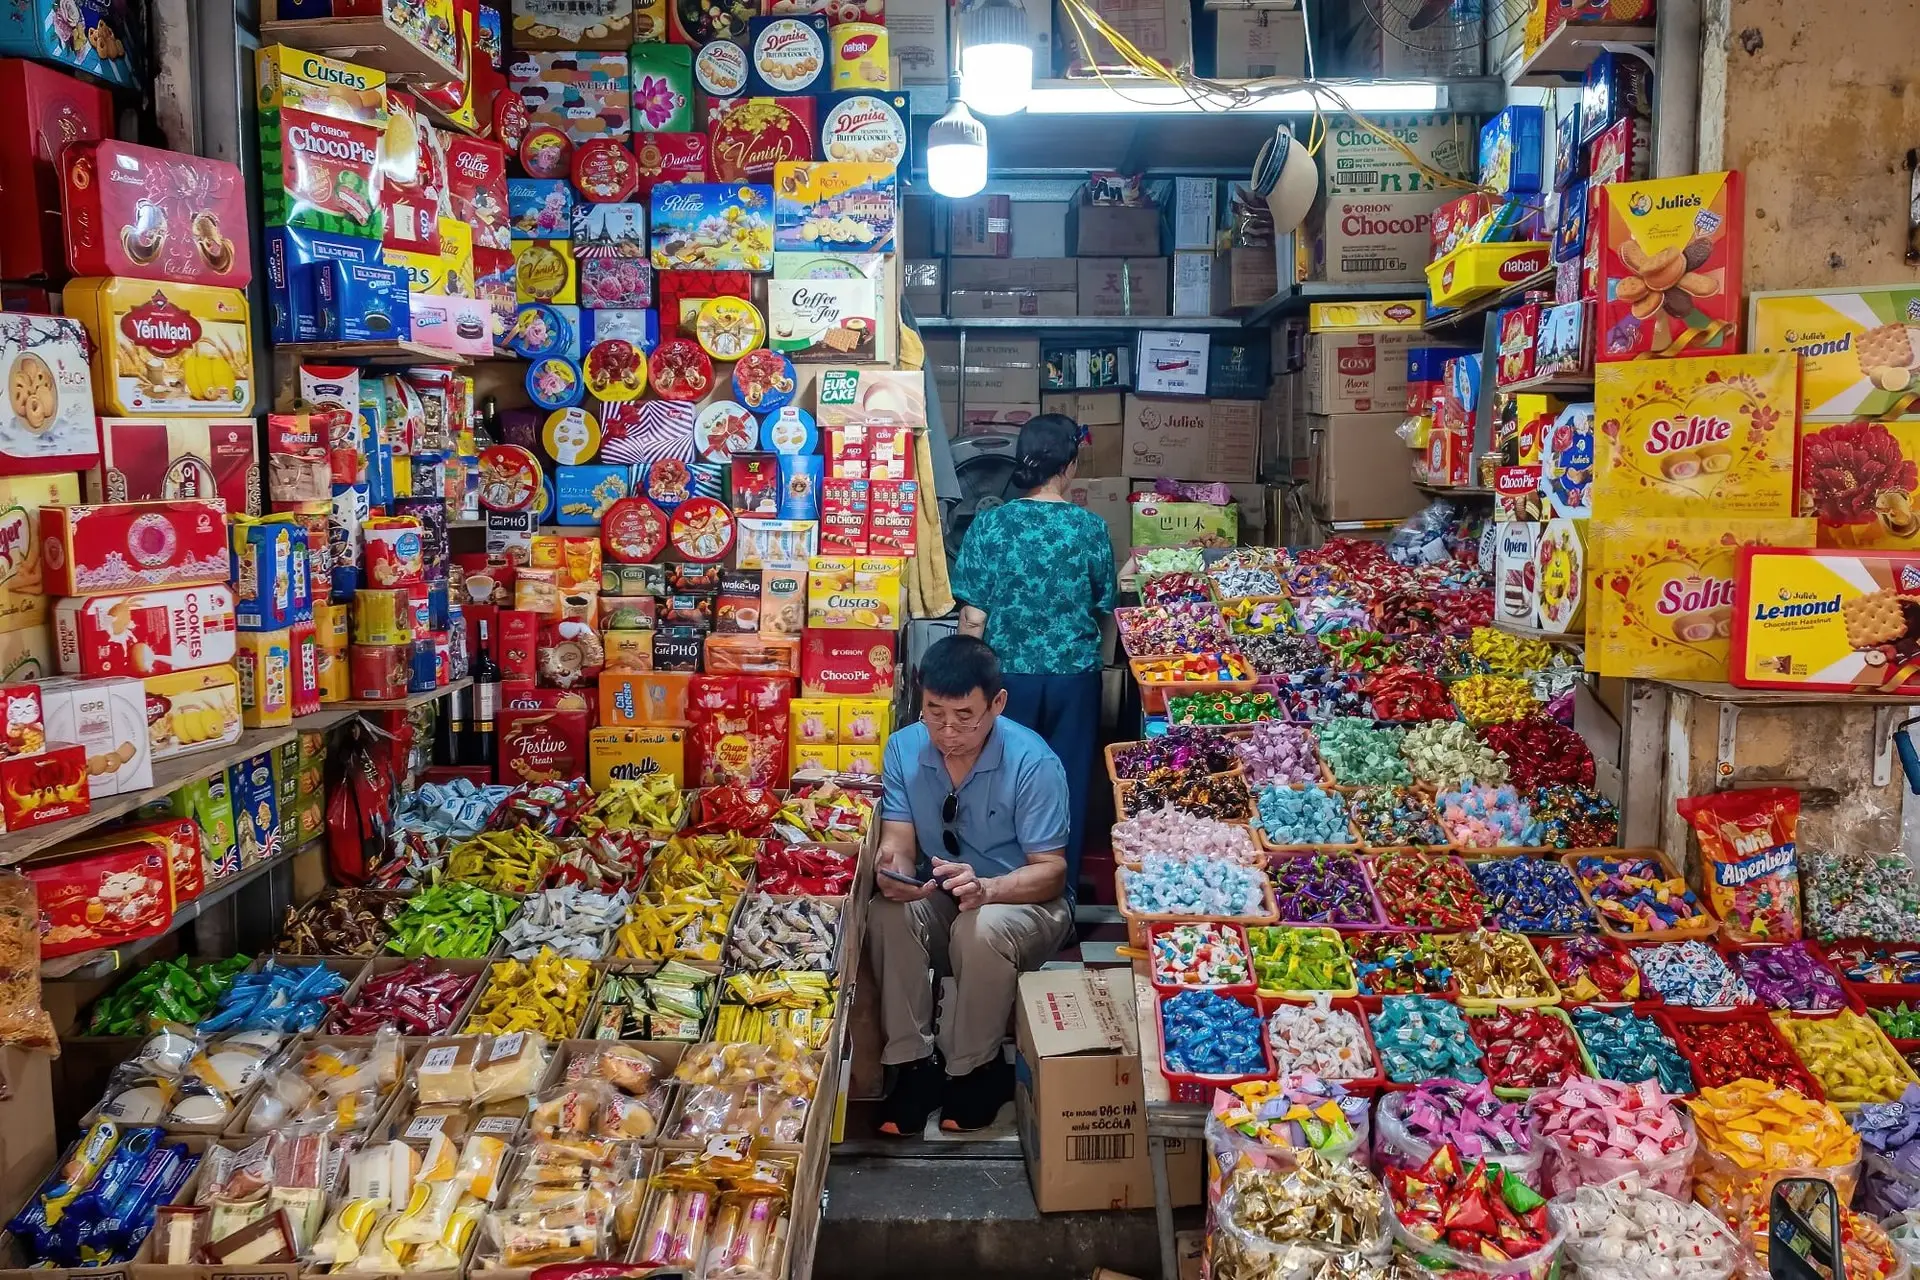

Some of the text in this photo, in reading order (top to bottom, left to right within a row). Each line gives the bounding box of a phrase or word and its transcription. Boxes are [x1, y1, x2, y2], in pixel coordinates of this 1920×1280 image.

[764, 31, 809, 50] Danisa
[303, 58, 366, 90] Custas
[834, 112, 887, 133] Danisa
[321, 125, 349, 139] ORION
[288, 126, 377, 165] ChocoPie
[455, 152, 490, 172] Ritaz
[661, 147, 704, 168] Daniel
[461, 169, 485, 180] GOLD
[820, 178, 850, 187] ROYAL
[660, 195, 704, 212] Ritaz
[1656, 193, 1701, 211] Julie's
[419, 209, 429, 241] COSY
[1503, 258, 1539, 273] nabati
[792, 288, 837, 309] Coffee
[810, 305, 840, 323] Joy
[1800, 332, 1826, 340] Julie's
[1340, 357, 1372, 369] COSY
[59, 372, 85, 385] PEACH
[823, 377, 856, 391] EURO
[822, 389, 855, 402] CAKE
[1164, 415, 1204, 429] Julie's
[1644, 415, 1732, 455] Solite
[1570, 455, 1590, 464] Julie's
[1500, 473, 1535, 489] ChocoPie
[816, 561, 846, 570] Custas
[861, 562, 892, 571] Custas
[722, 581, 760, 593] wake-up
[772, 580, 796, 592] Cozy
[828, 595, 879, 608] Custas
[1793, 591, 1817, 600] Julie's
[1755, 595, 1841, 621] Le-mond
[174, 609, 187, 646] MILK
[185, 593, 202, 660] COOKIES
[1763, 617, 1831, 629] Chocolate Hazelnut
[670, 642, 698, 656] PHỐ
[80, 701, 104, 712] GPR
[510, 699, 542, 710] COSY
[514, 734, 567, 756] Festive
[529, 756, 553, 766] Treats
[33, 805, 69, 820] Cookies
